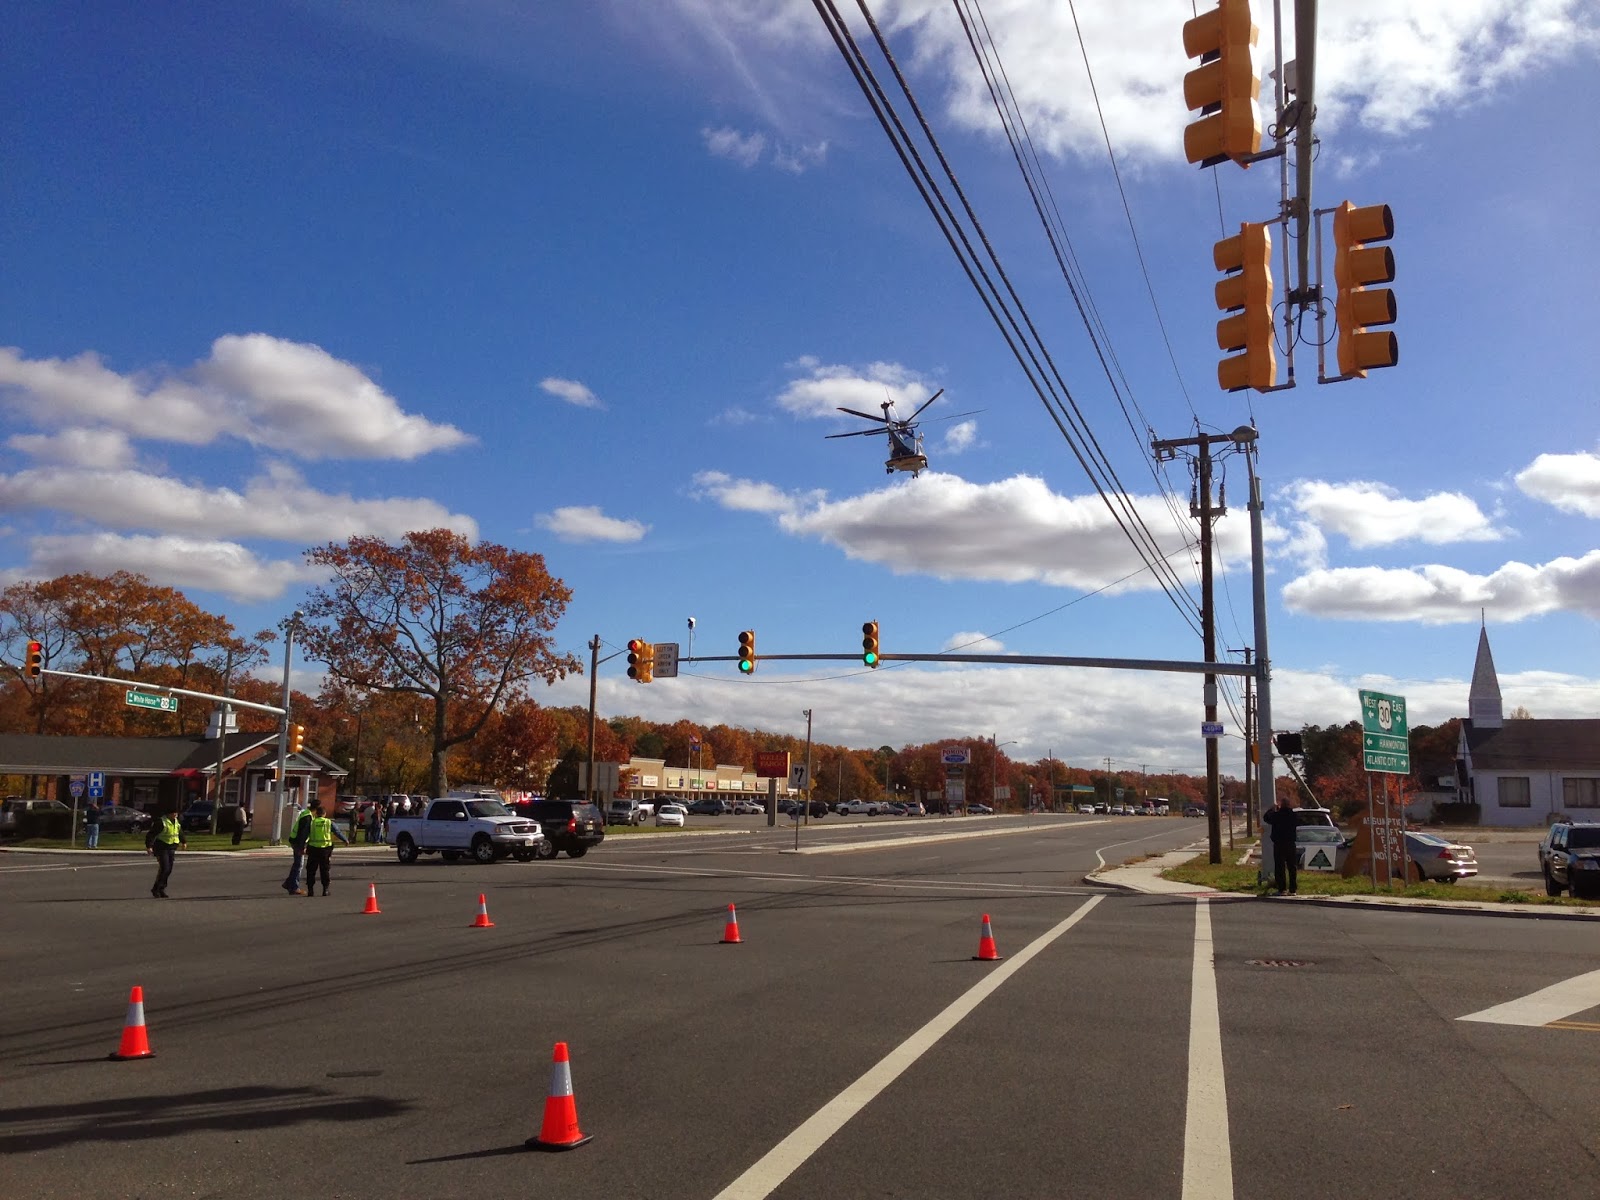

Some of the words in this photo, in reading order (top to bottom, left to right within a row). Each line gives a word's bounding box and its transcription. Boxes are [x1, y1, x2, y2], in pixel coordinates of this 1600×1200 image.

[133, 694, 145, 704] White
[144, 696, 156, 706] Horse
[1363, 695, 1376, 709] WEST
[1379, 706, 1390, 723] 30
[1392, 700, 1404, 713] EAST
[1379, 738, 1407, 751] HAMMONTON
[942, 749, 968, 757] POMONA
[1366, 754, 1387, 766] ATLANTIC
[1387, 756, 1398, 767] CITY
[1375, 827, 1400, 836] CRFT
[1380, 836, 1398, 845] FIR
